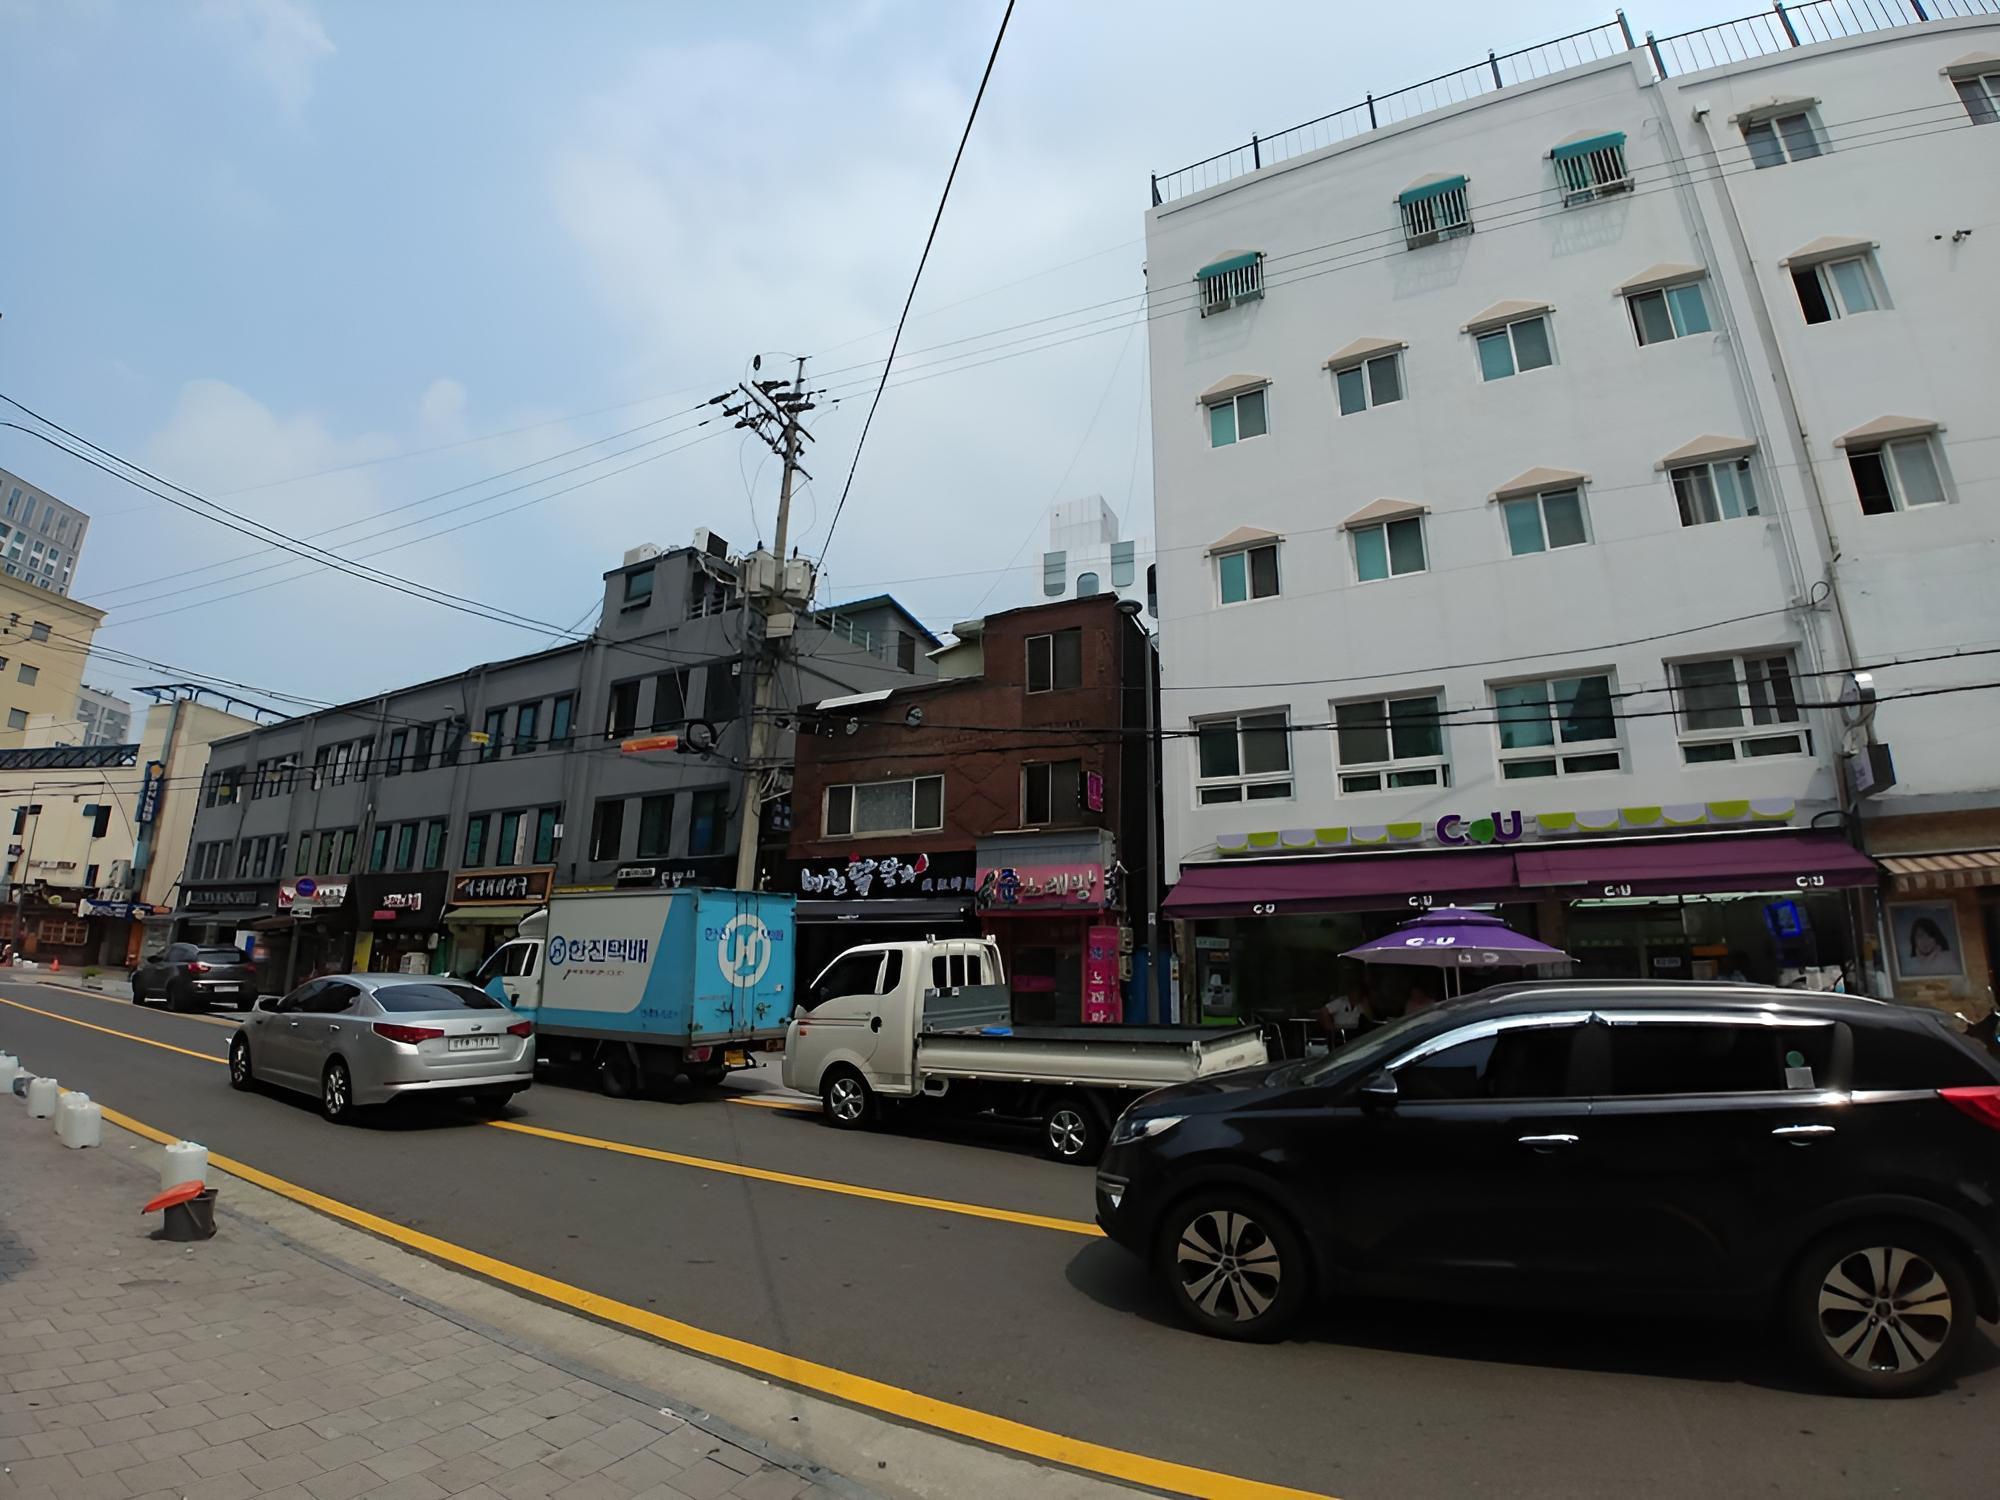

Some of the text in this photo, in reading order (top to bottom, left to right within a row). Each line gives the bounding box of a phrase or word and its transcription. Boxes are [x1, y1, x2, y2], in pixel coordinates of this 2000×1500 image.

[1435, 810, 1523, 845] CU
[1796, 875, 1825, 887] CU
[1604, 884, 1631, 896] CU
[1409, 895, 1432, 906] CU
